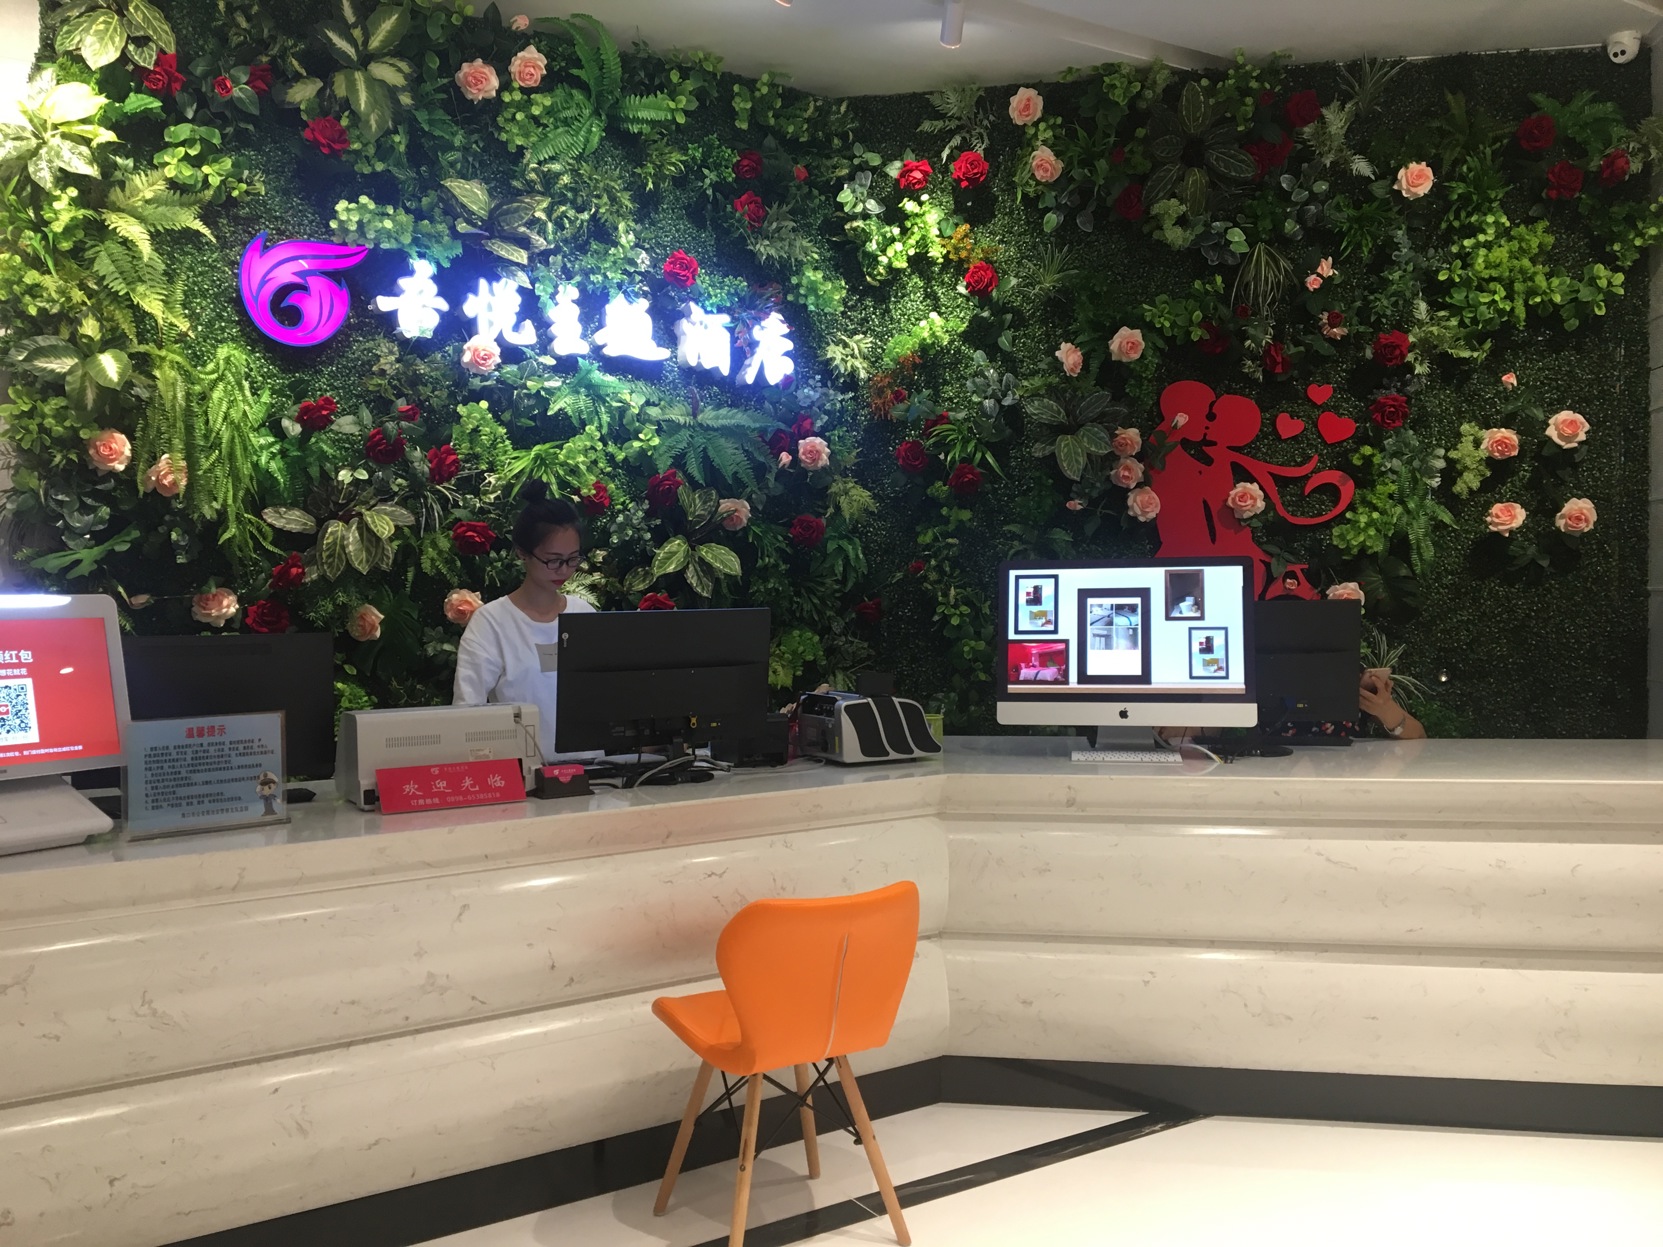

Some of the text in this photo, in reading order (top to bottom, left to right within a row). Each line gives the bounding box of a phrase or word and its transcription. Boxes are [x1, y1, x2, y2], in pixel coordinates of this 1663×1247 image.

[184, 724, 227, 739] 温馨提示
[402, 773, 506, 796] 欢迎光临
